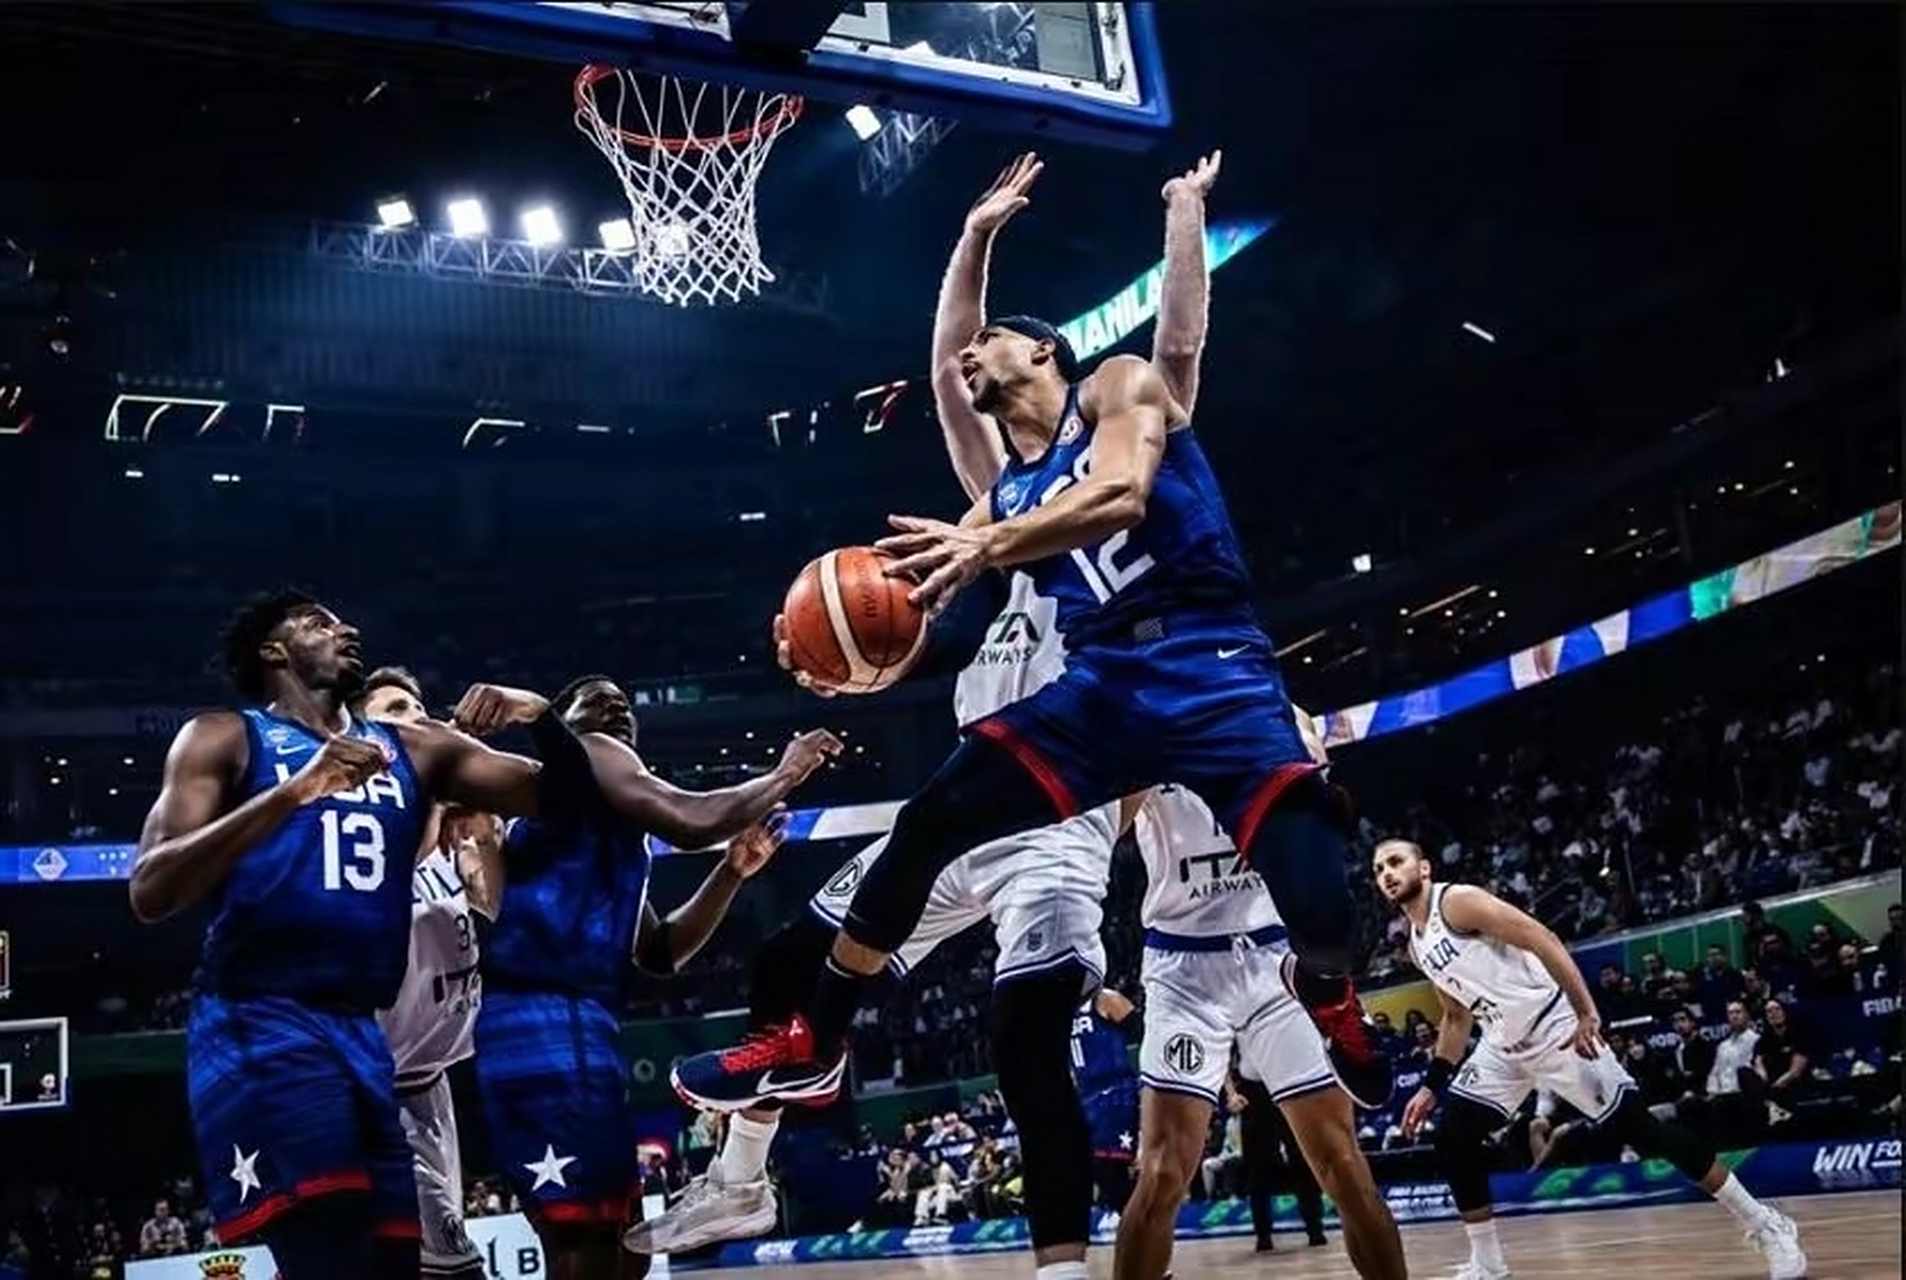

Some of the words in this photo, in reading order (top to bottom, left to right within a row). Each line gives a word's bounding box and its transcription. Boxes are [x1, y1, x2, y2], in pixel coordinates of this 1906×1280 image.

[1070, 529, 1156, 605] 12
[320, 809, 386, 892] 13
[1168, 1037, 1204, 1071] MG
[1813, 1142, 1875, 1173] WIN
